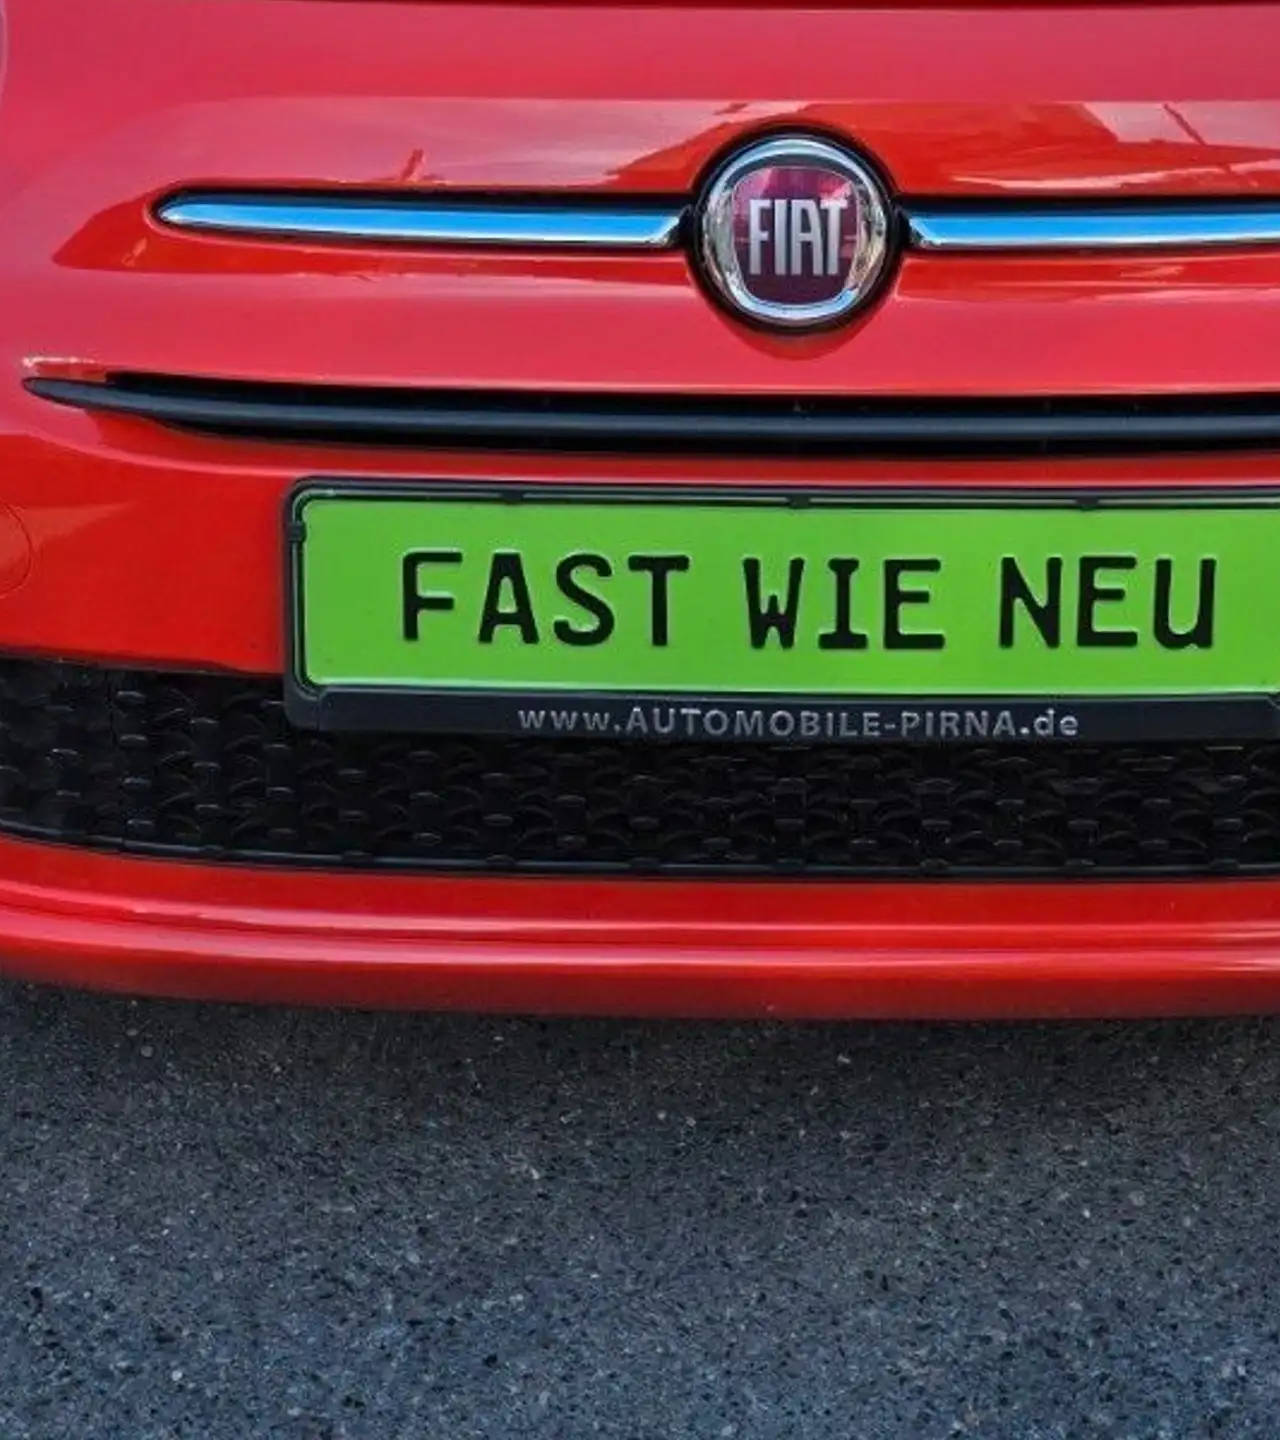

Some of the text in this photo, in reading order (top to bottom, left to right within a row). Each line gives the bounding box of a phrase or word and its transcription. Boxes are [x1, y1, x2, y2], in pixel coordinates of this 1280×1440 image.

[748, 197, 849, 277] FIAT
[399, 550, 1218, 651] FAST WIE NEU
[517, 706, 1080, 740] www.AUTOMOBILE-PIRNA.de
